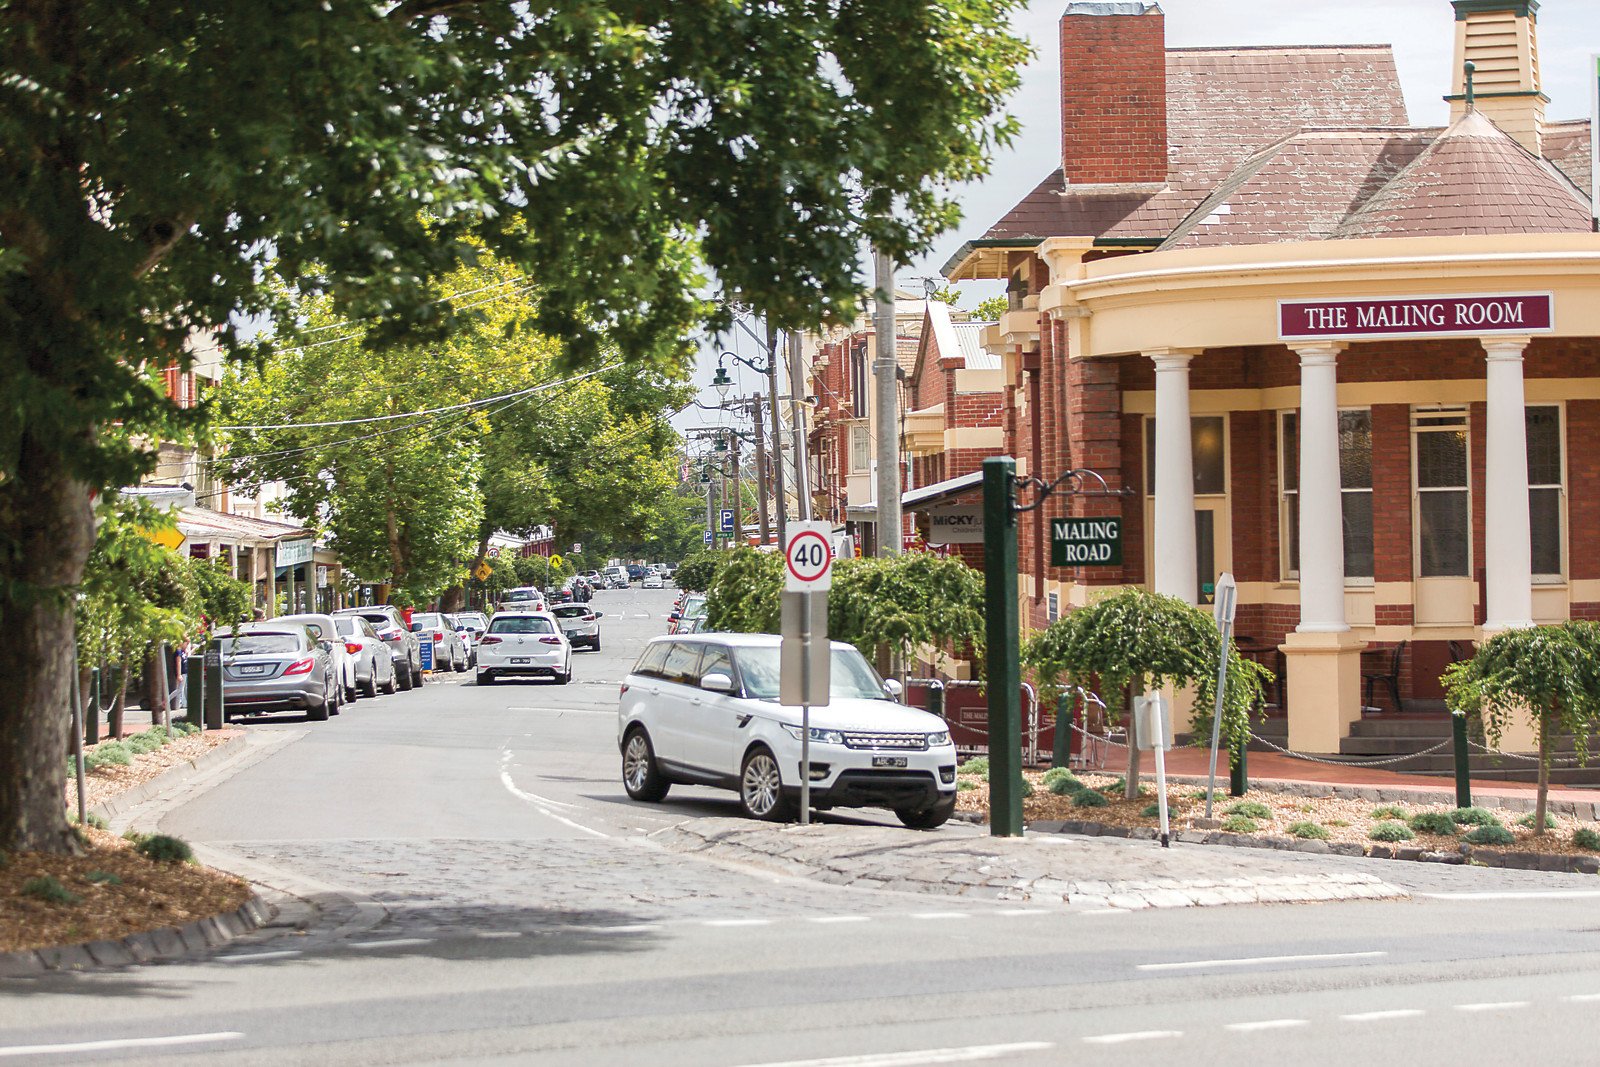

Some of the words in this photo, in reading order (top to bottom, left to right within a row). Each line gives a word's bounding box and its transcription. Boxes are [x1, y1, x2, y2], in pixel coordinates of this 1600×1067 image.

[1304, 307, 1348, 329] THE
[1356, 304, 1445, 328] MALING
[1454, 301, 1524, 325] ROOM
[723, 512, 732, 523] P
[1054, 521, 1118, 541] MALING
[794, 543, 823, 567] 40
[1065, 543, 1112, 563] ROAD
